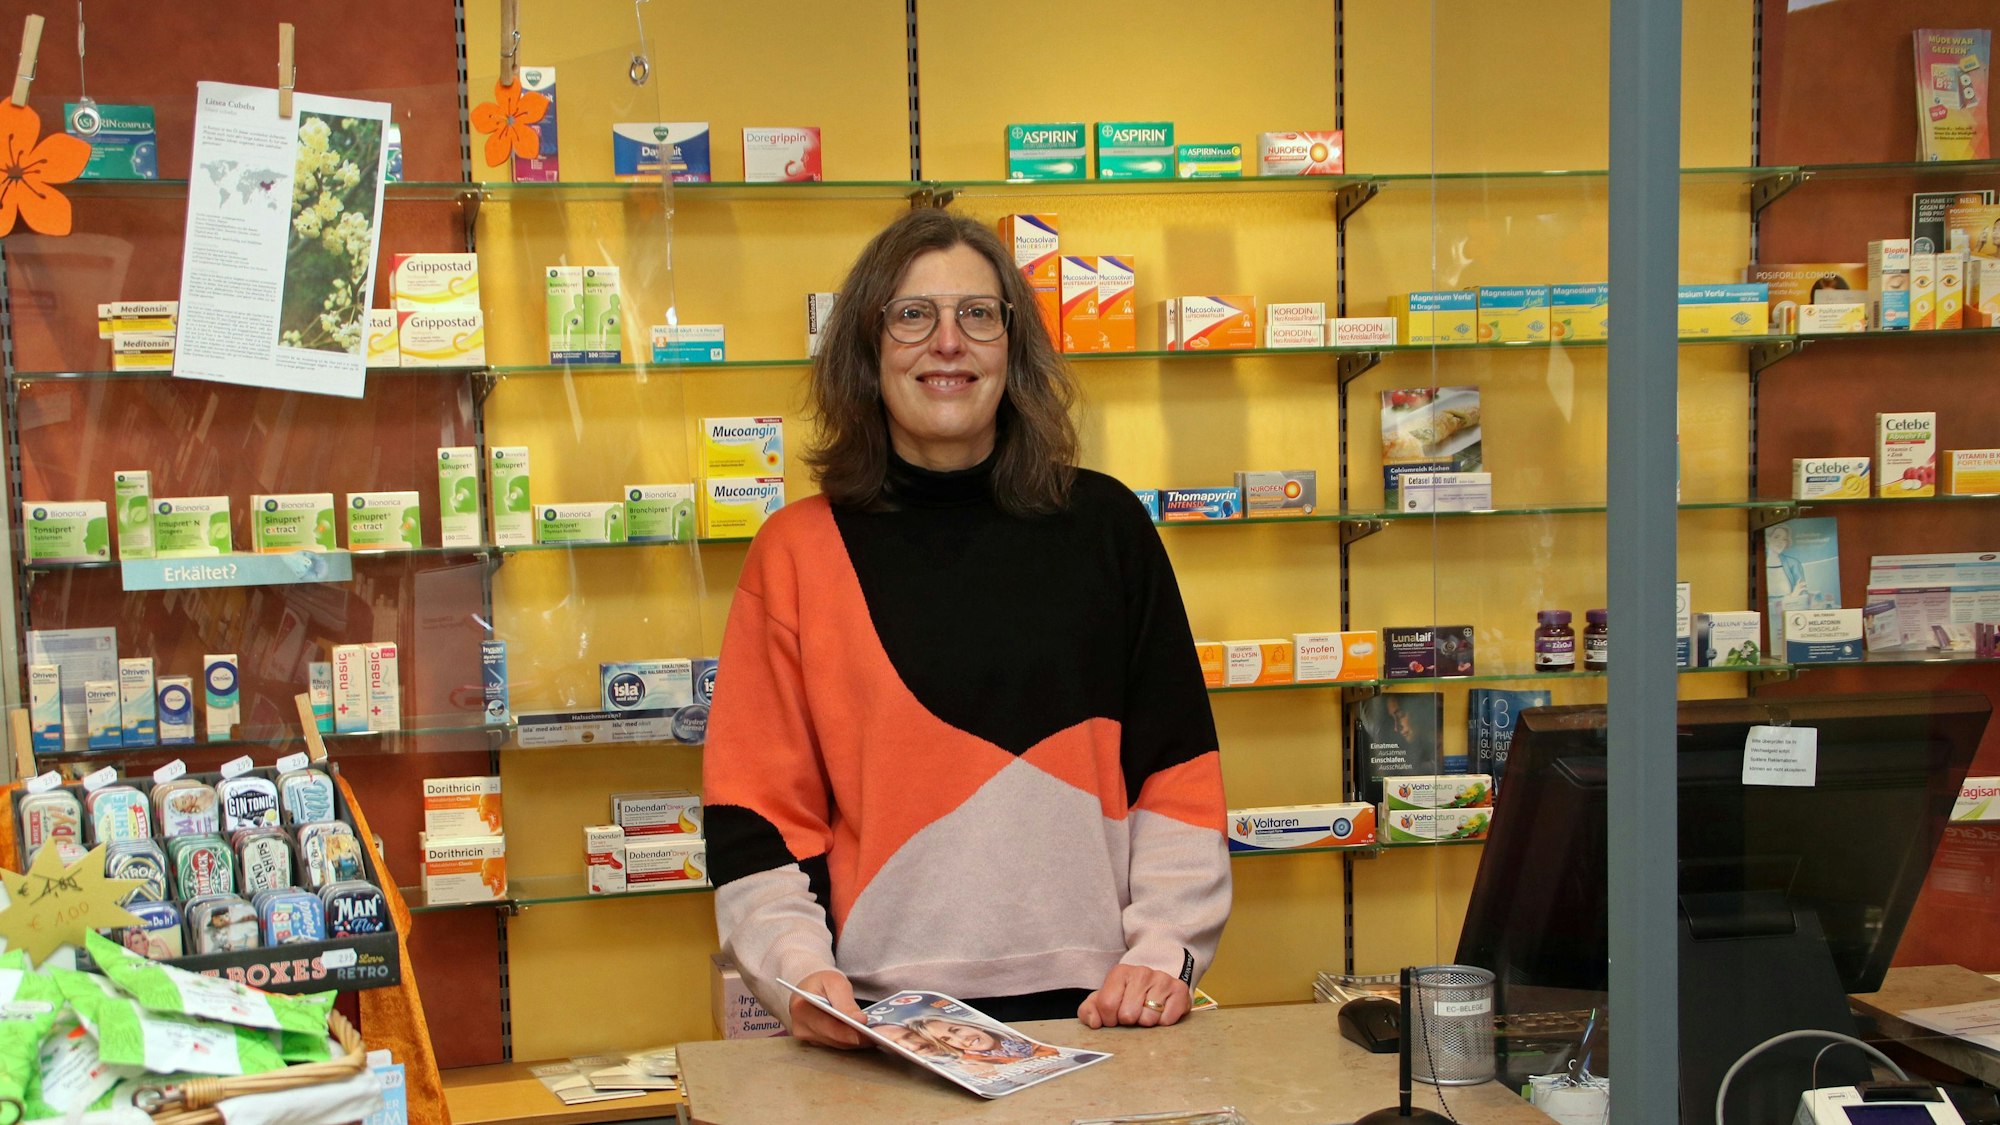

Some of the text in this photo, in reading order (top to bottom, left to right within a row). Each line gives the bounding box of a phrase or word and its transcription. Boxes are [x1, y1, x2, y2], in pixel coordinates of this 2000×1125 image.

[1929, 34, 1973, 46] MÜDE WAR
[1932, 46, 1967, 55] GESTERN
[205, 98, 256, 112] Litsea Cubeba
[746, 132, 806, 145] Doregrippin
[1022, 129, 1077, 144] ASPIRIN
[1113, 128, 1166, 142] ASPIRIN
[1187, 147, 1217, 156] ASPIRIN
[1267, 146, 1308, 155] NUROFEN
[1016, 236, 1057, 244] Mucosolvan
[406, 260, 472, 275] Grippostad
[1481, 288, 1545, 299] Magnesium Verla
[1553, 287, 1597, 296] Magnesium
[1410, 294, 1452, 303] Magnesium
[120, 305, 168, 314] Meditonsin
[1185, 306, 1225, 314] Mucosolvan
[1274, 307, 1313, 315] KORODIN
[410, 316, 476, 330] Grippostad
[1337, 323, 1383, 332] KORODIN
[1273, 329, 1312, 337] KORODIN
[123, 340, 170, 348] Meditonsin
[1886, 418, 1930, 431] Cetebe
[712, 424, 777, 438] Mucoangin
[441, 462, 470, 471] Sinupret
[495, 461, 524, 470] Sinupret
[1805, 461, 1850, 475] Cetebe
[1408, 476, 1457, 485] Cefasel nutri
[644, 491, 677, 499] Bionorica
[714, 484, 778, 498] Mucoangin
[1167, 491, 1237, 503] Thomapyrin
[280, 501, 315, 509] Bionorica
[367, 499, 401, 507] Bionorica
[1167, 502, 1205, 510] INTENSIV
[50, 510, 86, 518] Bionorica
[629, 506, 668, 515] Bronchipret
[265, 516, 301, 526] Sinupret
[352, 512, 388, 523] Sinupret
[33, 525, 72, 535] Tonsipret
[265, 525, 297, 534] extract
[353, 523, 382, 531] extract
[544, 522, 577, 530] Bronchipret
[163, 562, 238, 583] Erkältet?
[1391, 632, 1431, 643] Lunalaif
[1300, 646, 1335, 655] Synofen
[32, 671, 58, 680] Otriven
[121, 668, 150, 677] Otriven
[335, 653, 348, 690] nasic
[368, 652, 381, 689] nasic
[613, 682, 639, 697] isla
[87, 690, 117, 700] Otriven
[571, 712, 622, 721] Halsschmerzen?
[1494, 698, 1511, 730] 3
[1495, 731, 1515, 741] PHAS
[1371, 756, 1406, 764] Einschlafen.
[1378, 763, 1413, 771] Ausschlafen
[427, 783, 481, 794] Dorithricin
[1411, 783, 1453, 791] VoltaNatura
[227, 794, 276, 816] GIN TONIC
[624, 803, 666, 813] Dobendan
[1413, 813, 1455, 821] VoltaNatura
[1253, 818, 1299, 829] Voltaren
[429, 848, 483, 859] Dorithricin
[629, 850, 671, 860] Dobendan
[333, 894, 381, 923] MAN
[153, 915, 163, 926] Do
[350, 917, 376, 932] Flu
[226, 956, 328, 986] BOXES
[337, 965, 389, 980] RETRO
[740, 1007, 753, 1019] ist
[1446, 1003, 1483, 1013] EC-BELEGE
[743, 1020, 782, 1032] Sommer
